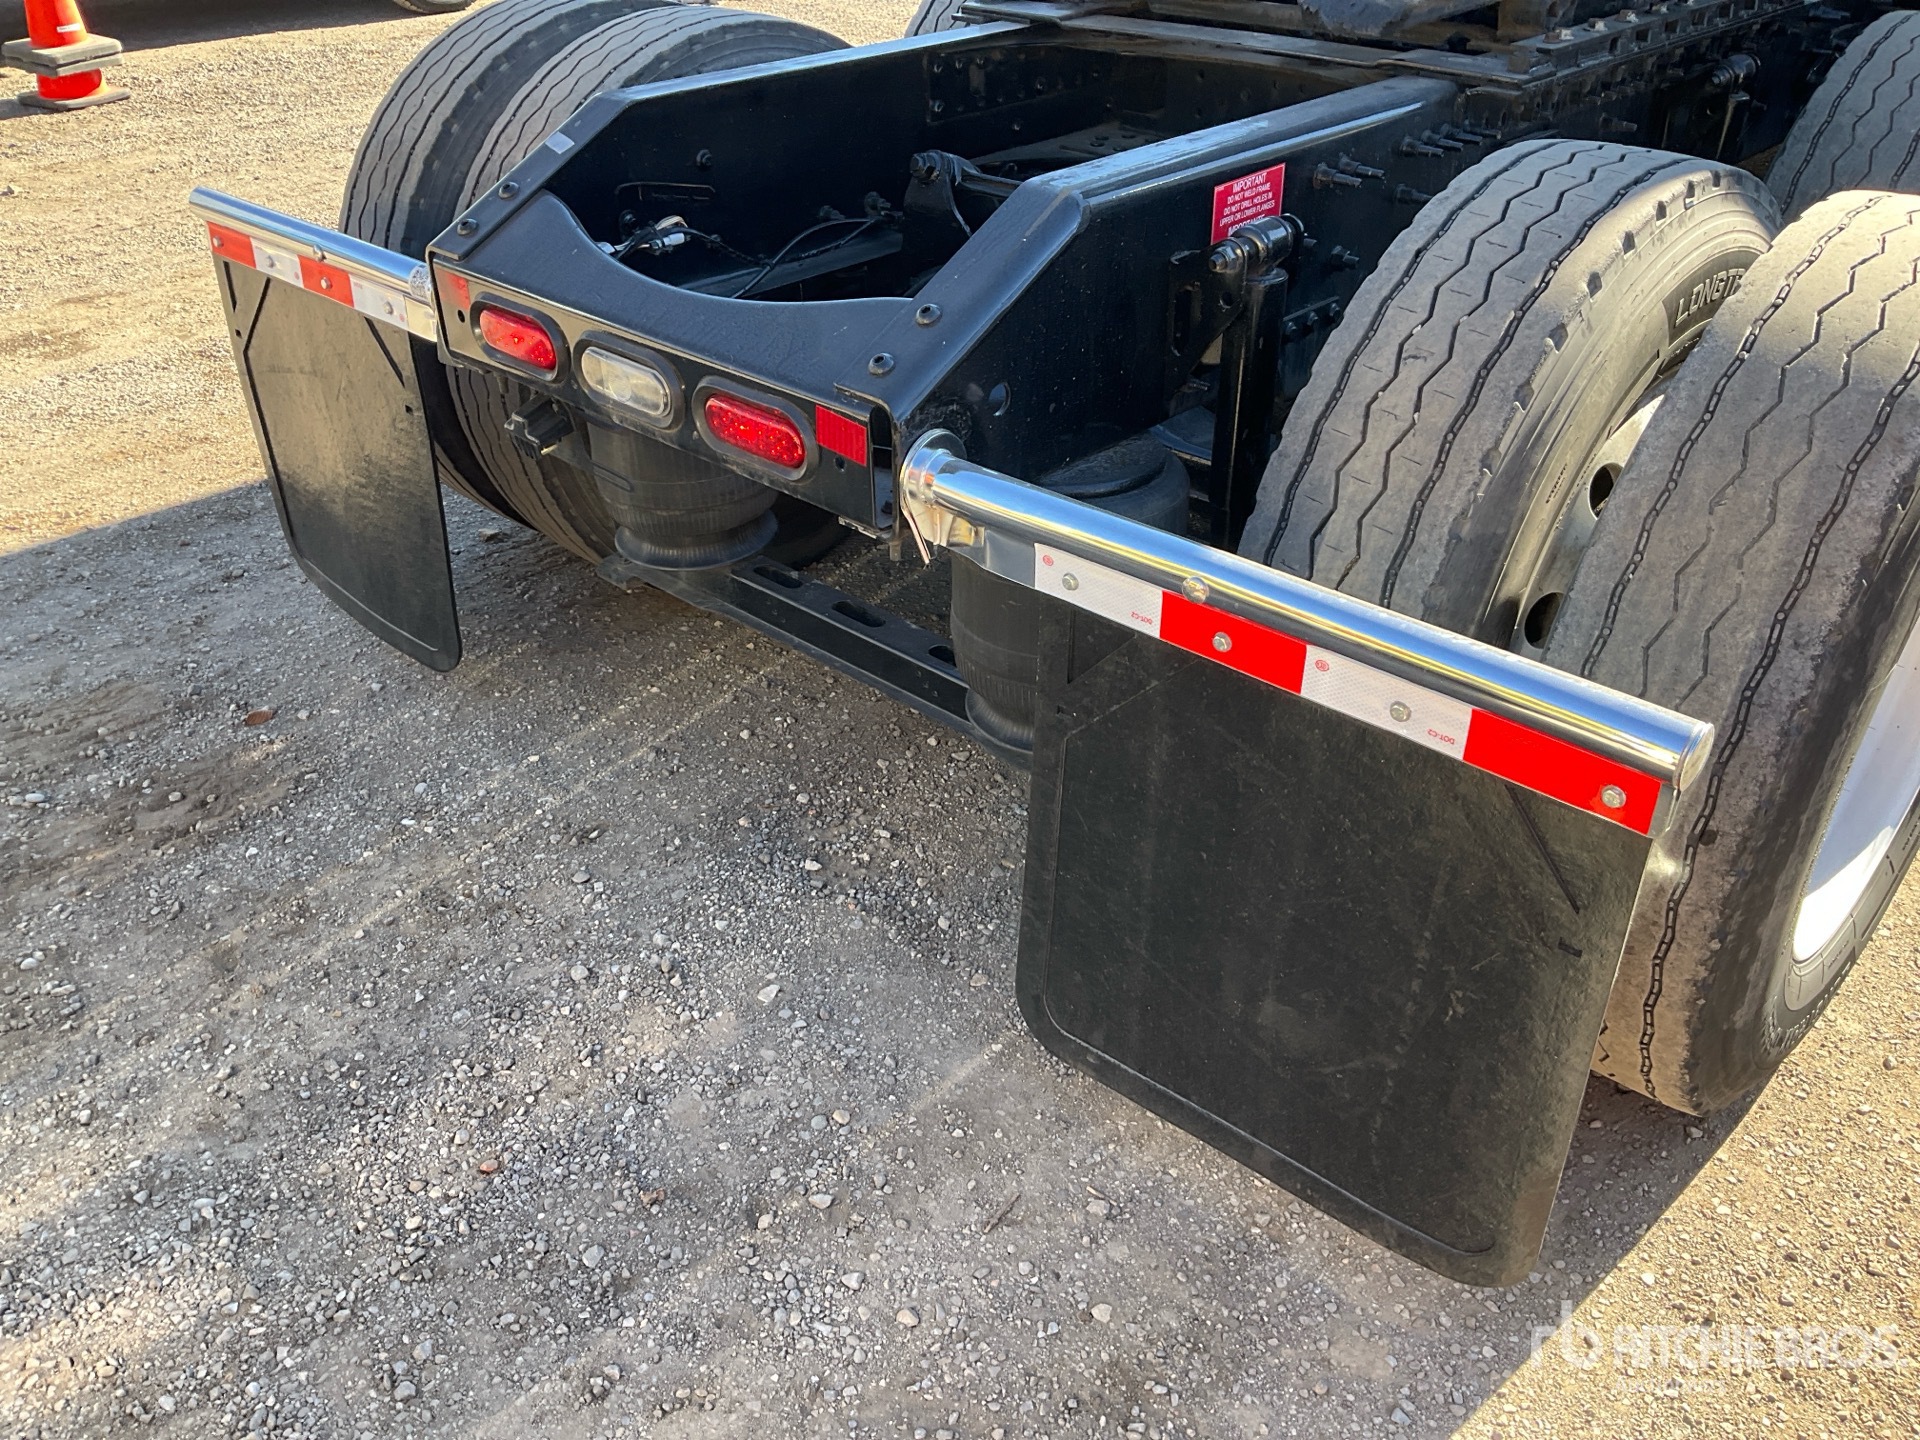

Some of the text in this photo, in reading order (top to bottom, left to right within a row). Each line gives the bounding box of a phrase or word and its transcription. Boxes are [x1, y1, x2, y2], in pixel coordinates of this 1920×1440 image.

[1233, 173, 1267, 192] IMPORTANT
[1224, 207, 1231, 215] DO
[1231, 203, 1241, 213] NOT
[1241, 198, 1253, 210] DRILL
[1253, 194, 1268, 204] HOLES
[1228, 195, 1235, 204] DO
[1235, 192, 1244, 201] NOT
[1220, 215, 1233, 226] UPPER
[1233, 211, 1241, 221] OR
[1241, 206, 1256, 218] LOWER
[1256, 199, 1275, 213] FLANGES
[1131, 611, 1153, 625] DOT-C2
[1427, 729, 1455, 745] DOT-C2
